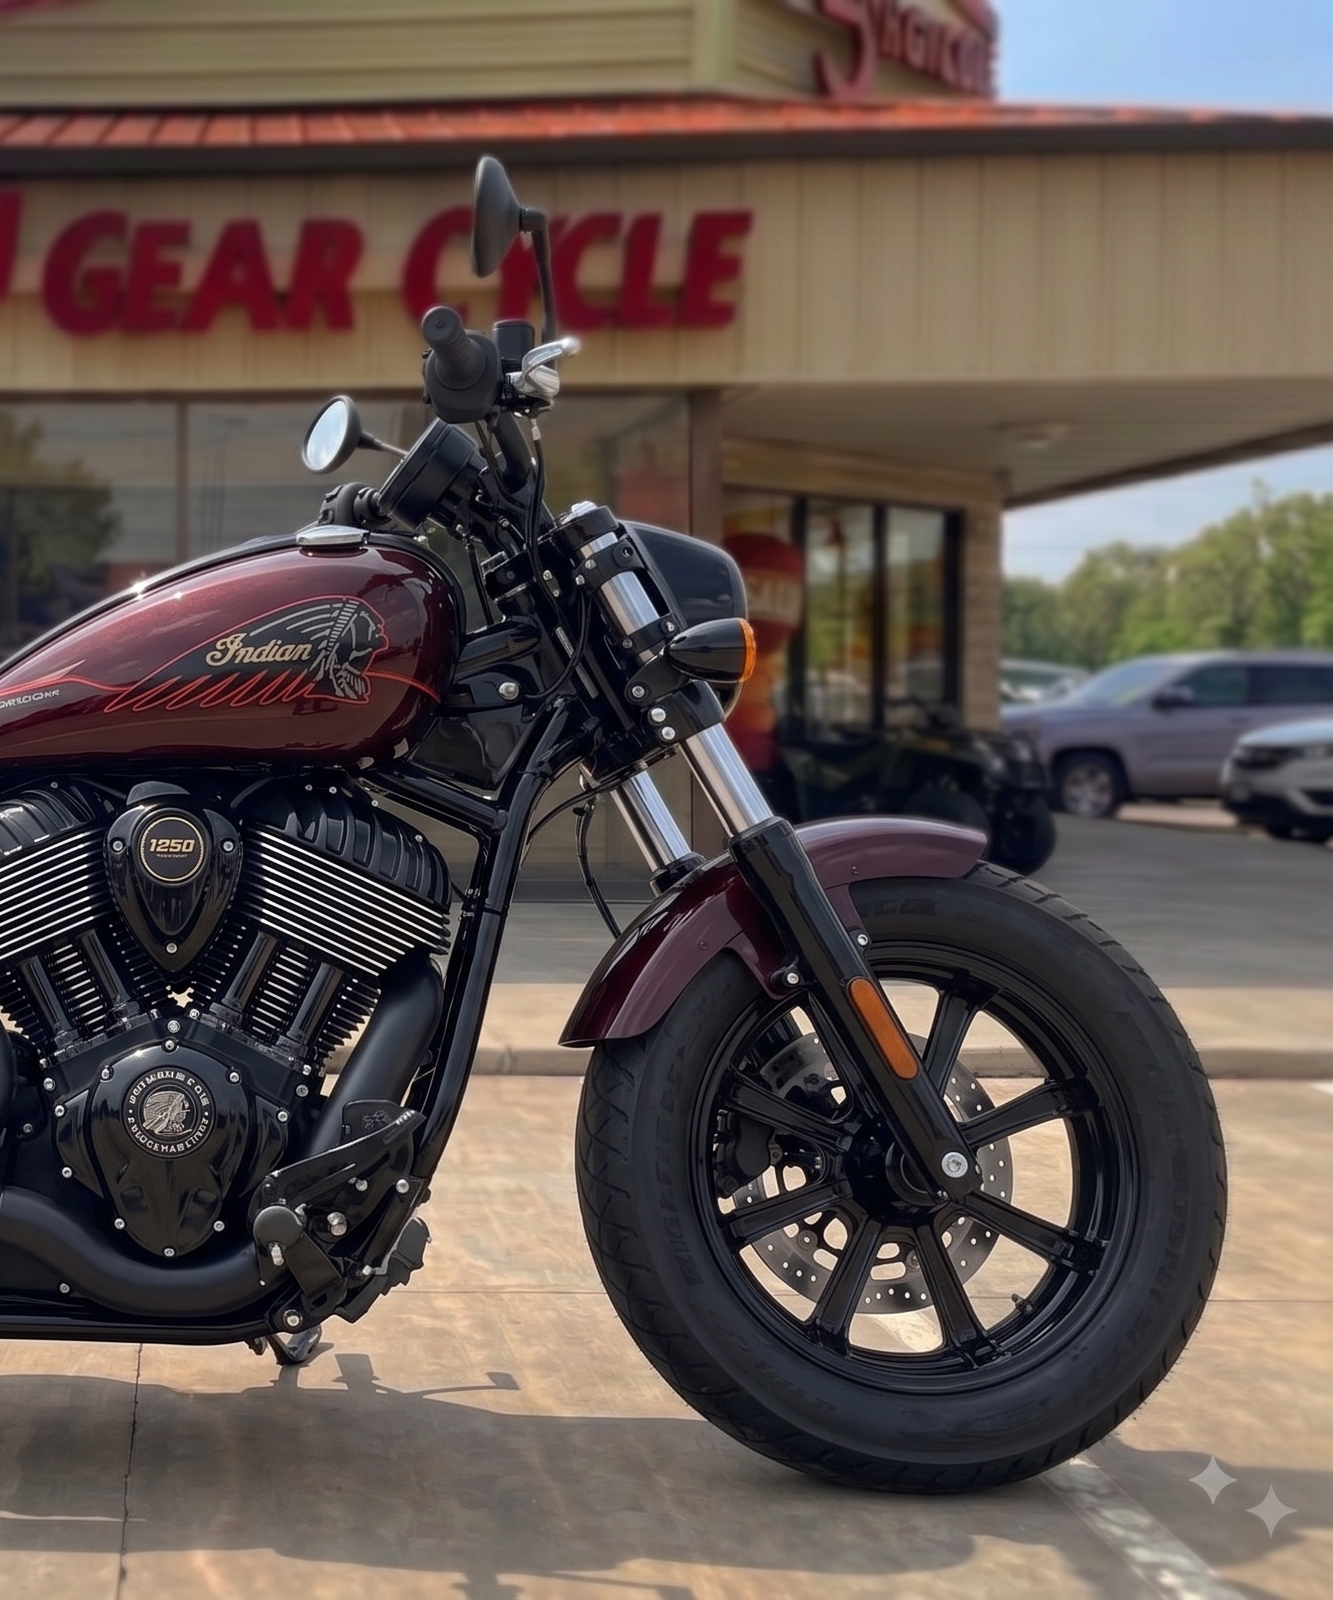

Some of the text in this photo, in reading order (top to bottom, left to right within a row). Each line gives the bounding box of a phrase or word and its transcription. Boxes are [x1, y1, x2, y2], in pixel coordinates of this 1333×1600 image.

[42, 208, 364, 337] GEAR
[402, 204, 753, 332] CYCLE
[206, 632, 313, 667] Indian
[149, 838, 196, 852] 1250
